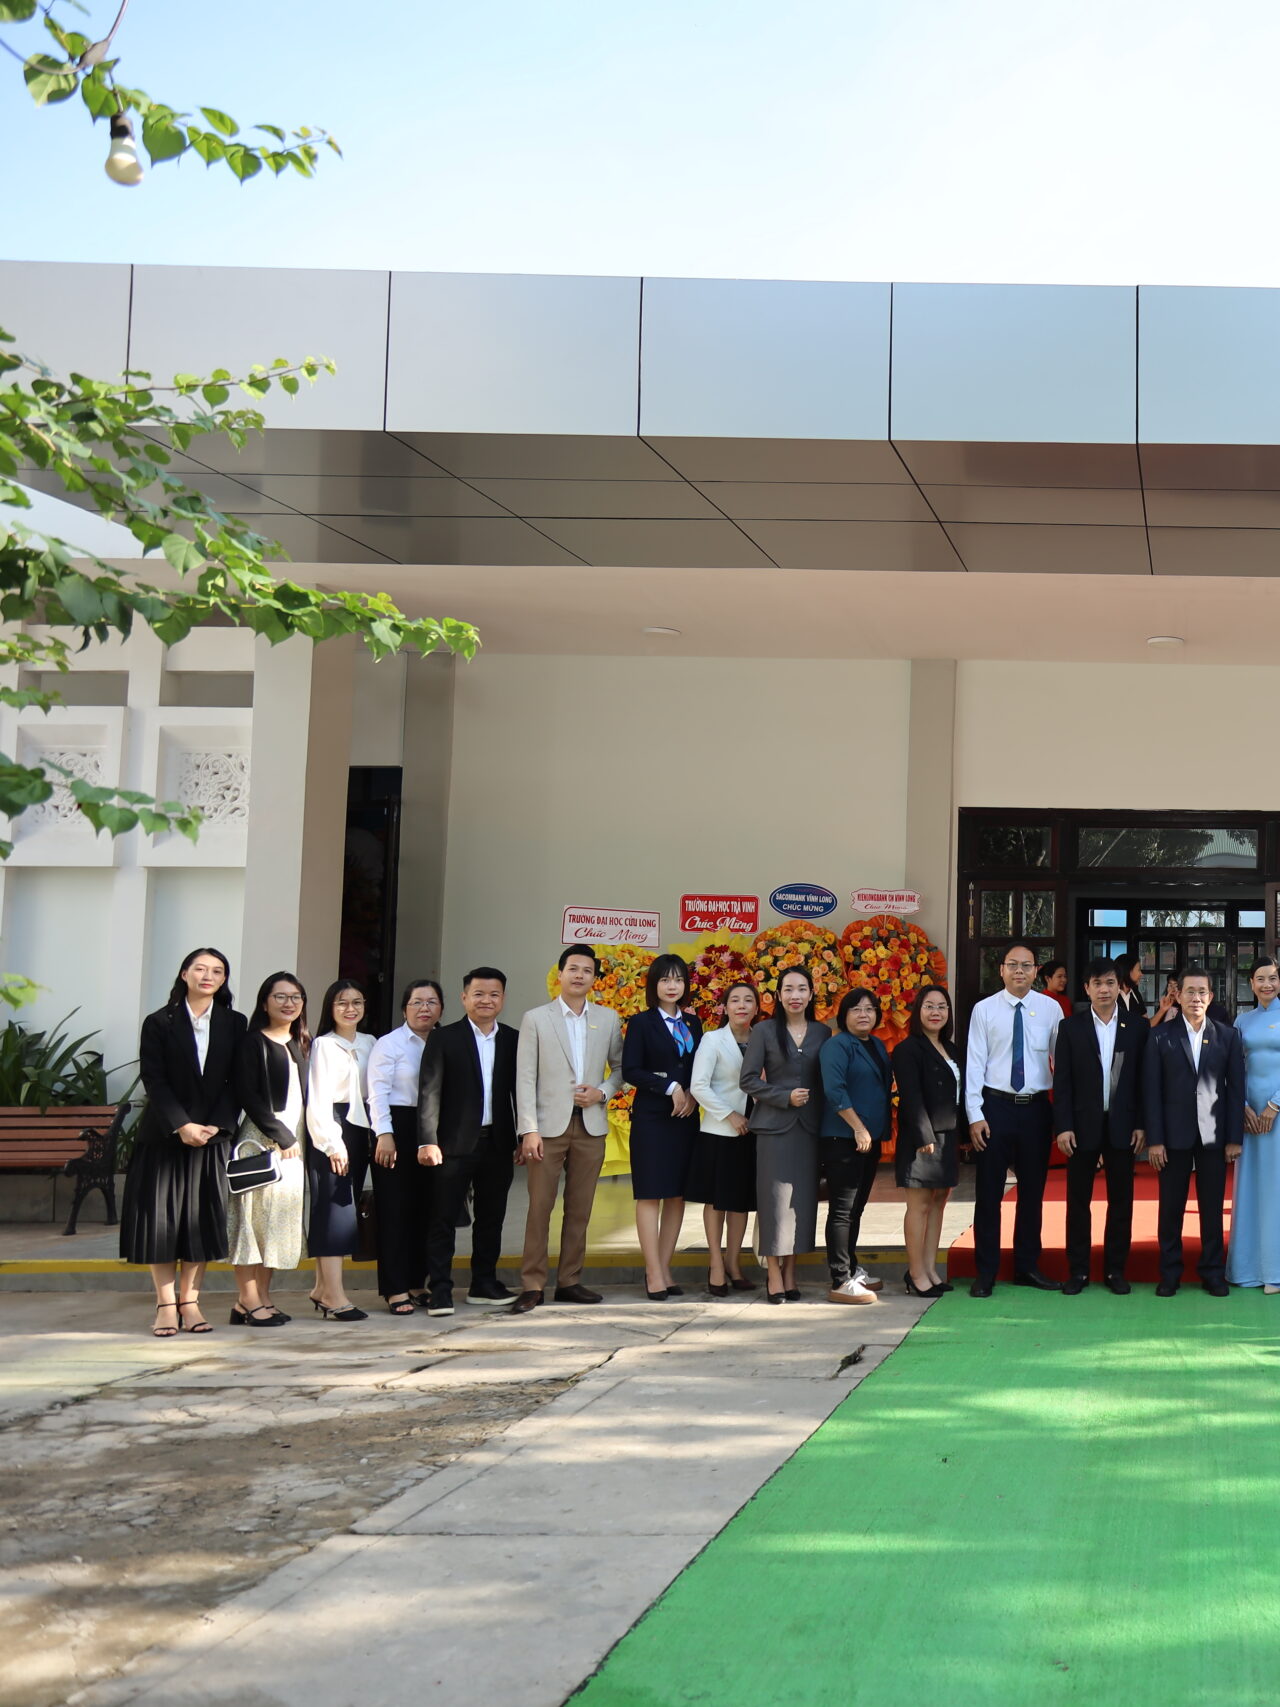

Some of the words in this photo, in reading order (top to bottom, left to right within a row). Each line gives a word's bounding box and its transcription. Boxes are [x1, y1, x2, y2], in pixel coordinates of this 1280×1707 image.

[776, 893, 806, 902] SACOMBANK
[685, 897, 707, 912] TRƯỜNG
[742, 902, 756, 913] VINH
[782, 902, 802, 911] CHÚC
[639, 919, 656, 928] LONG
[685, 916, 714, 929] Chúc
